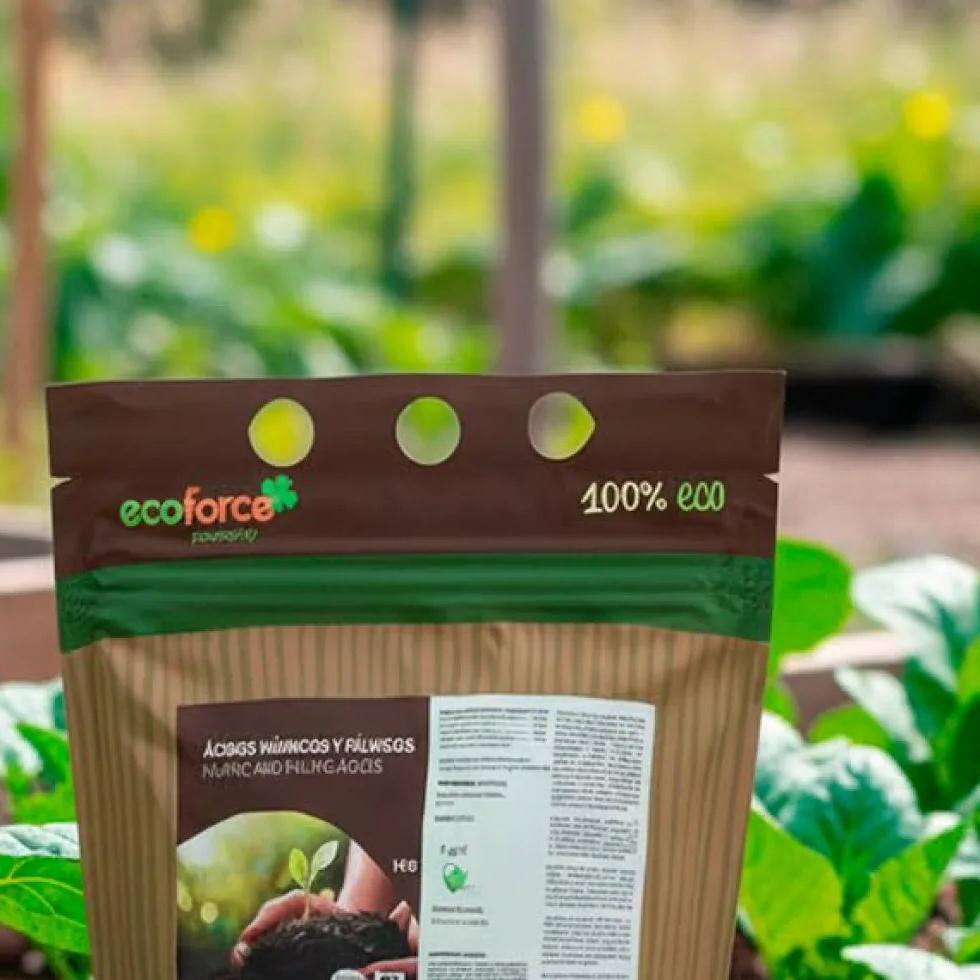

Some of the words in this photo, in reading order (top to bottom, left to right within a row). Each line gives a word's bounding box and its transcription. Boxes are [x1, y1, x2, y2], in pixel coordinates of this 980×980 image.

[119, 485, 276, 527] ecoforce
[580, 480, 668, 514] 100%
[676, 481, 726, 511] eco
